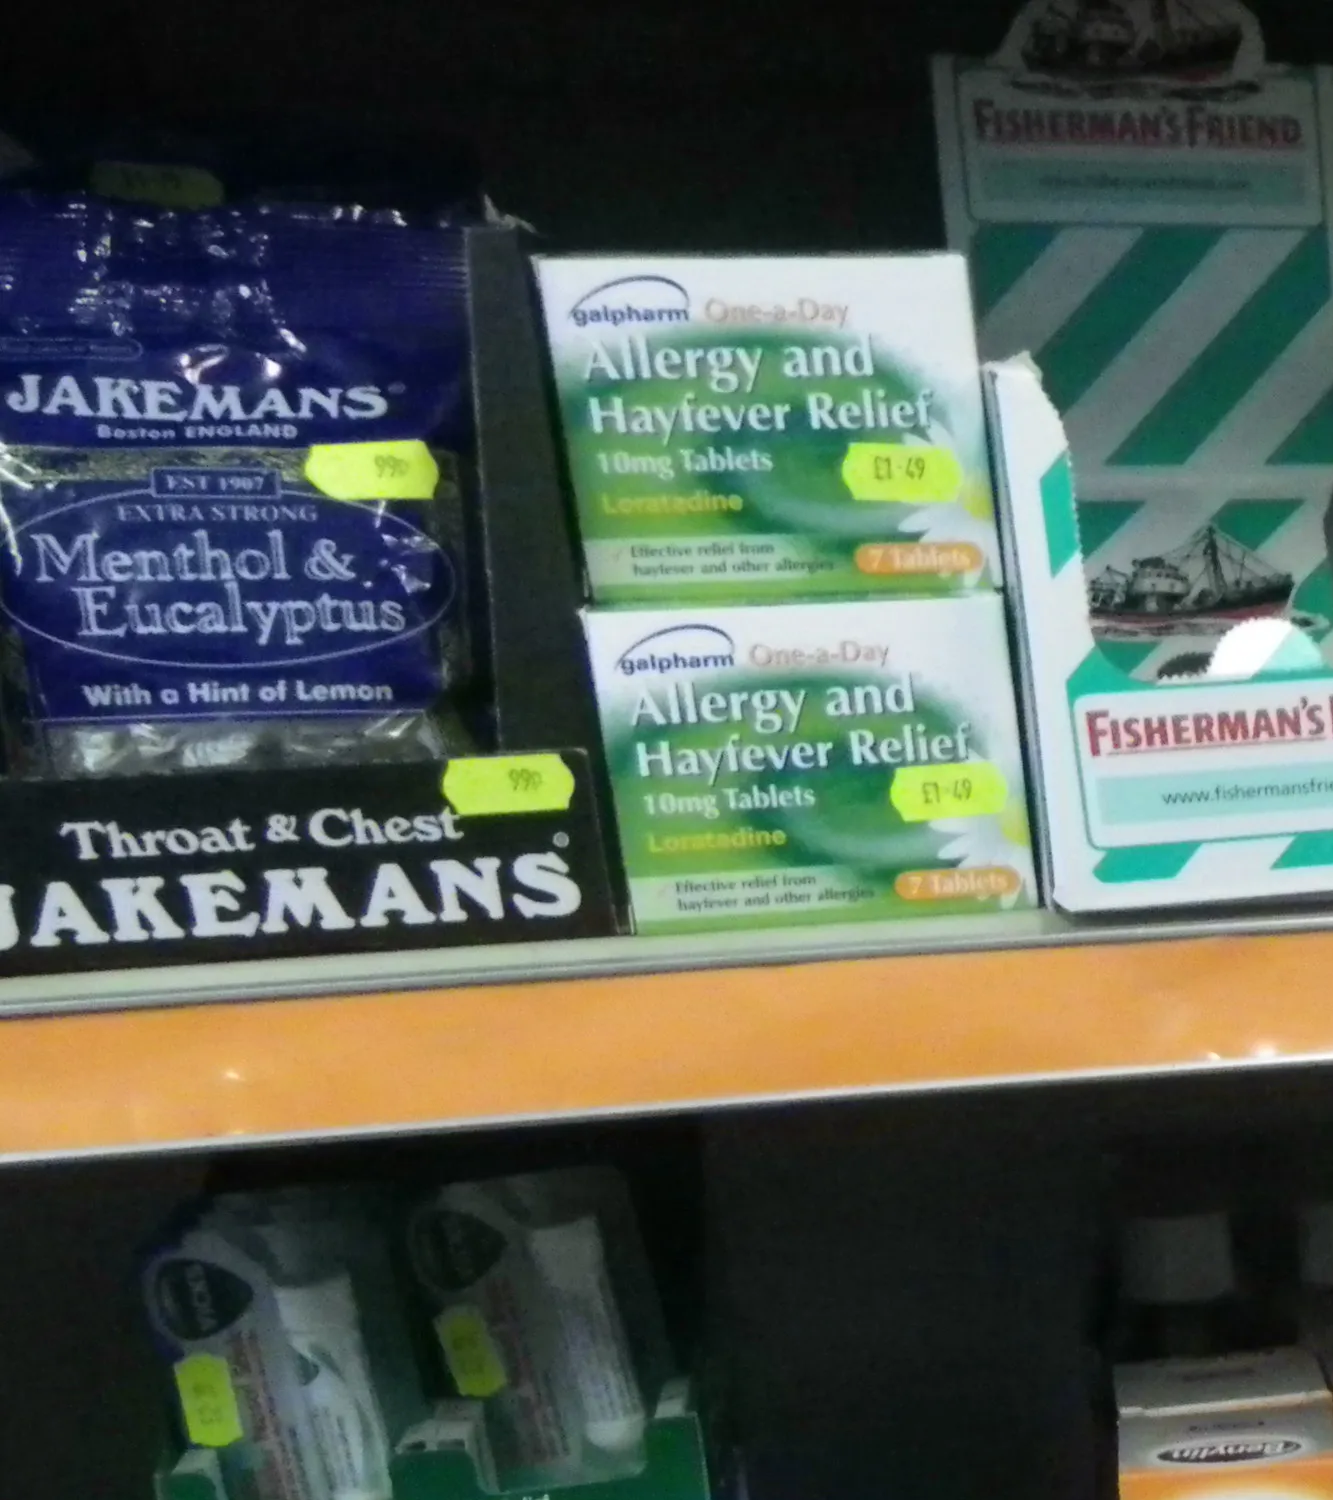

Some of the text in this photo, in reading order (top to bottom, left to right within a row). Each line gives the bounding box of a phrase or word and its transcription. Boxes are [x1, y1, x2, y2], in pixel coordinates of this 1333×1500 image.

[973, 101, 1302, 146] FISHERMAN'S FRIEND
[572, 306, 690, 326] galpharm
[704, 298, 849, 327] One-a-Day
[586, 334, 874, 392] Allergy and
[8, 374, 389, 422] JAKEMANS
[588, 389, 934, 446] Hayfever Relief
[600, 448, 773, 479] 10mg Tablets
[117, 505, 318, 524] EXTRA STRONG
[31, 530, 356, 582] Menthol &
[74, 582, 406, 644] Eucalyptus
[621, 654, 734, 675] galpharm
[749, 641, 890, 667] One-a-Day
[83, 680, 393, 707] With a Hint of Lemon
[632, 672, 915, 735] Allergy and
[1085, 697, 1325, 757] FISHERMAN'S
[637, 723, 972, 786] Hayfever Relief
[644, 787, 816, 818] 10mg Tablets
[61, 807, 464, 860] Throat & Chest
